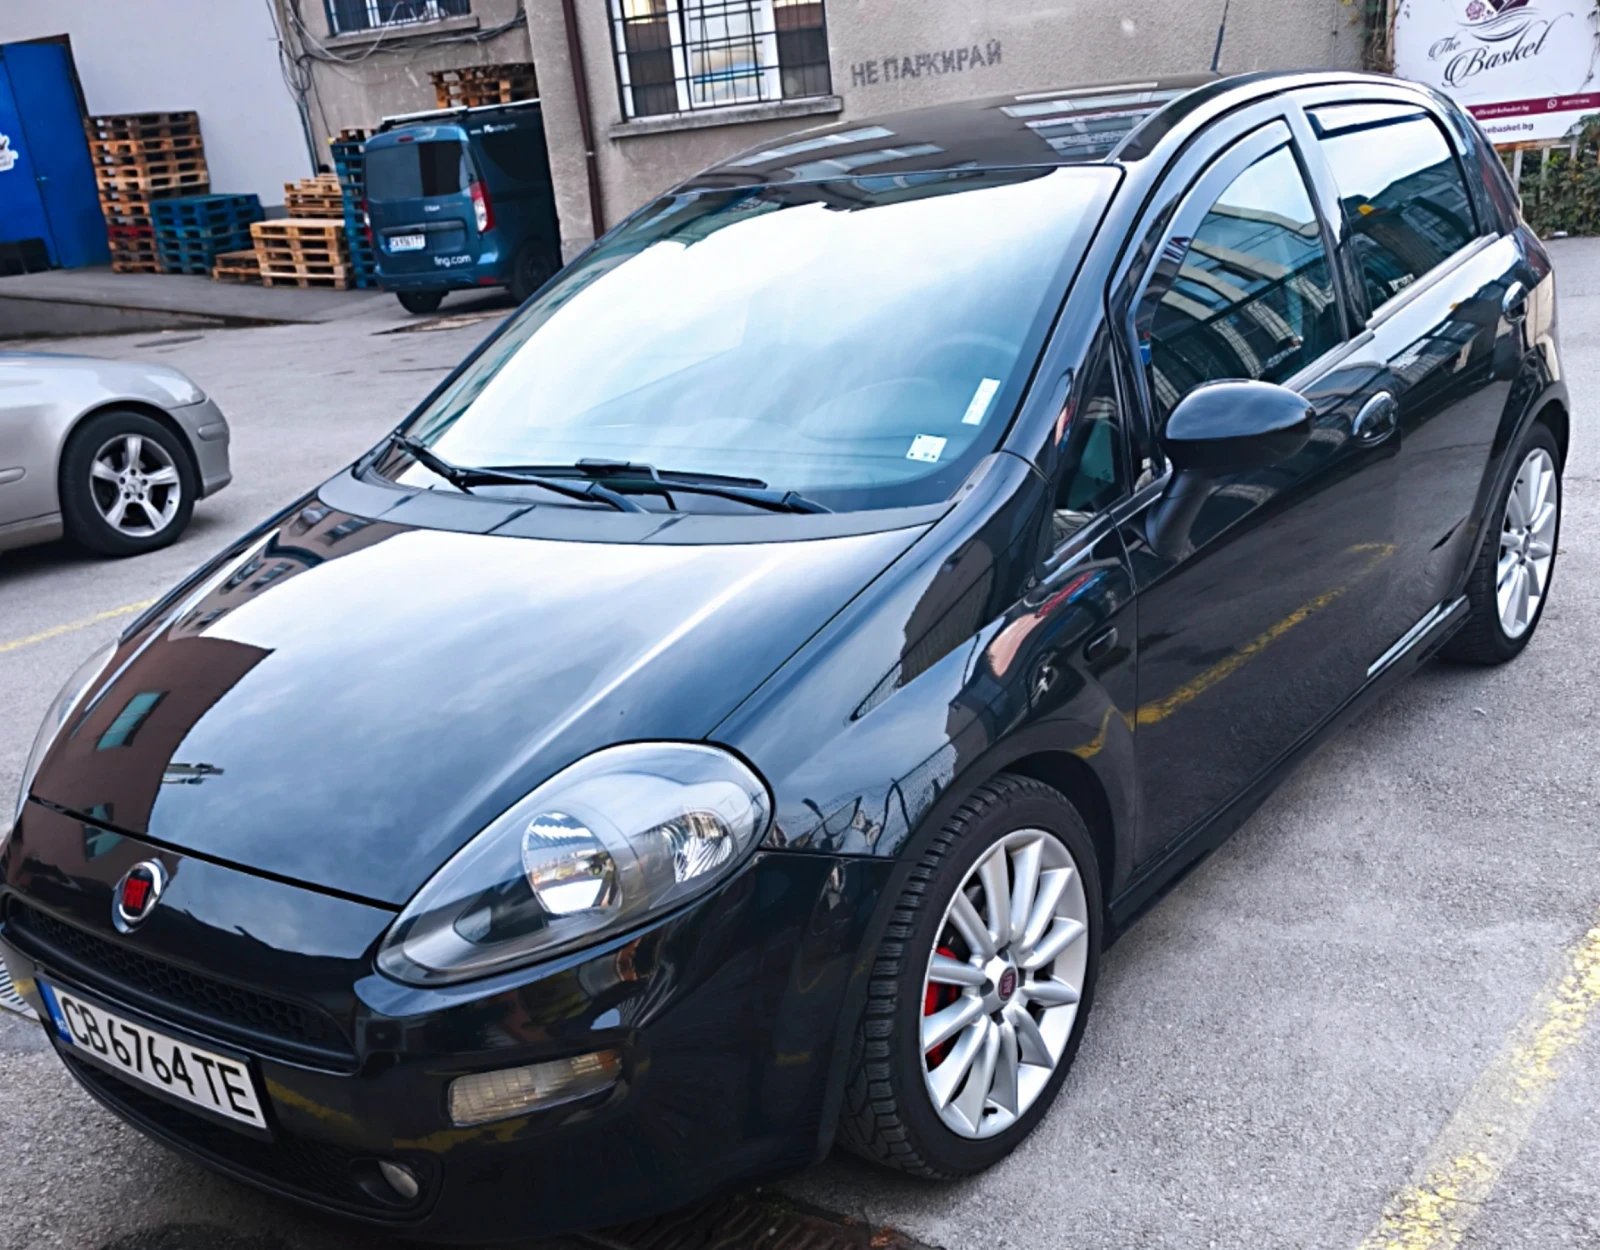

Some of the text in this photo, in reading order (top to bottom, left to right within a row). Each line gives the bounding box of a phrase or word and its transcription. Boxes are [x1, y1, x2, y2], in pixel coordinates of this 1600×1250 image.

[851, 38, 1003, 87] НЕ ПАРКИРАЙ
[1427, 29, 1468, 61] The
[1442, 12, 1574, 88] Basket
[61, 996, 257, 1119] CB 6764 TE
